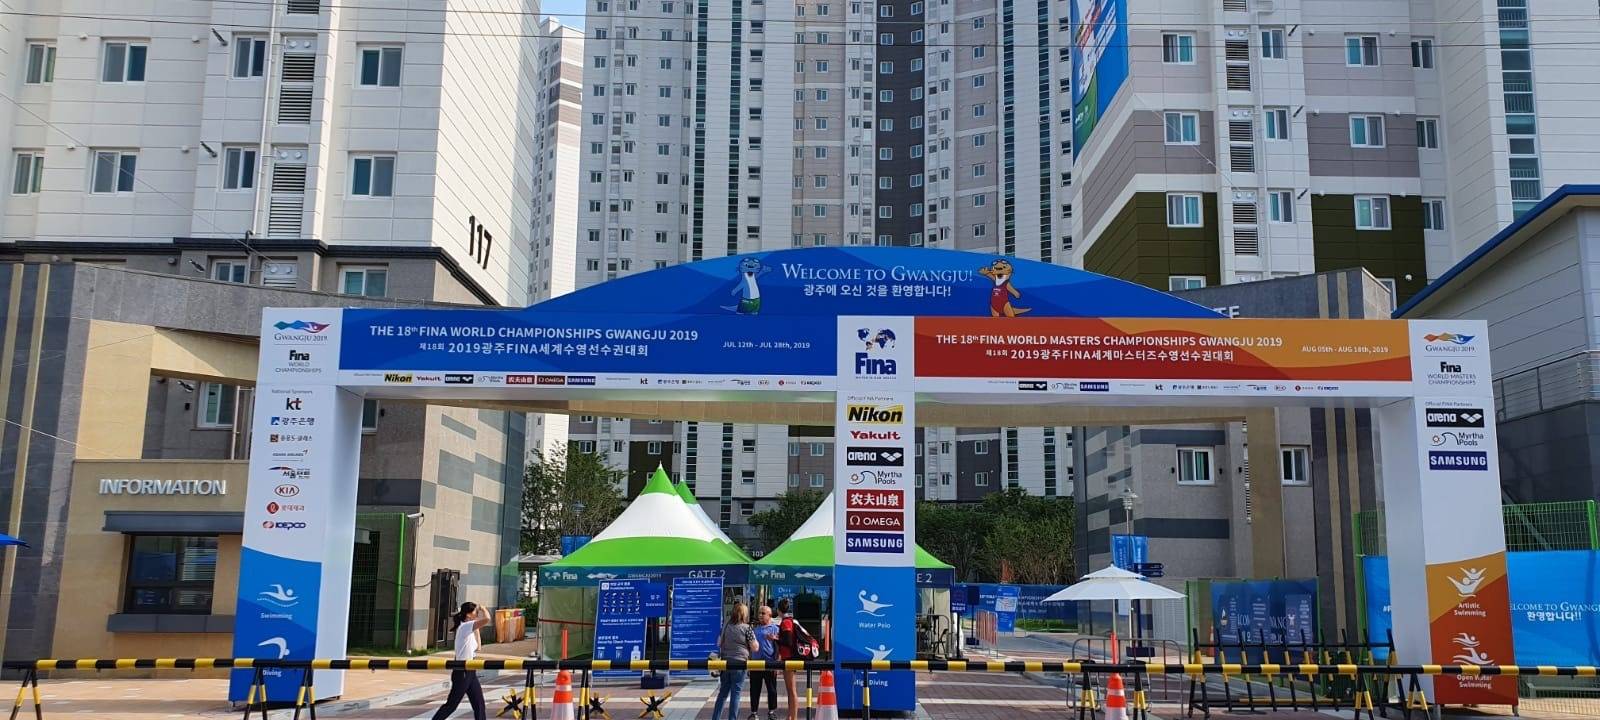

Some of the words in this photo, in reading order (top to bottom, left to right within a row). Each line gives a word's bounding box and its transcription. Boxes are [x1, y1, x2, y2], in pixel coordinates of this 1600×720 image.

[468, 215, 492, 269] 117
[781, 263, 861, 281] WELCOME
[864, 268, 886, 281] TO
[890, 263, 974, 283] GWANGJU!
[803, 284, 837, 297] 광주에
[840, 285, 863, 297] 오신
[866, 285, 888, 297] 것을
[891, 284, 952, 297] 환영합니다!
[274, 333, 312, 342] GWANGJU
[370, 325, 395, 337] THE
[419, 326, 448, 337] FINA
[450, 327, 495, 338] WORLD
[498, 327, 602, 339] CHAMPIONSHIPS
[605, 329, 667, 341] GWANGJU
[670, 330, 698, 341] 2019
[722, 341, 737, 349] JUL
[794, 342, 811, 350] 2019
[936, 334, 957, 345] THE
[980, 335, 1005, 345] FINA
[1006, 335, 1047, 346] WORLD
[1049, 336, 1101, 346] MASTERS
[1103, 336, 1196, 347] CHAMPIONSHIPS
[1199, 336, 1254, 347] GWANGJU
[1256, 337, 1282, 347] 2019
[419, 342, 445, 351] 제18회
[448, 342, 649, 357] 2019광주FINA세계수영선수권대회
[289, 350, 310, 361] Fina
[986, 349, 1008, 357] 제18회
[1011, 349, 1234, 362] 2019광주FINA세계마스터즈수영선수권대회
[855, 352, 897, 375] Fina
[1440, 361, 1461, 373] Fina
[384, 374, 412, 383] Nikon
[286, 398, 302, 410] kt
[848, 406, 903, 423] Nikon
[1427, 413, 1457, 423] arena
[282, 417, 315, 426] 광주은행
[850, 430, 901, 440] Yakult
[1458, 432, 1484, 441] Myrtha
[848, 451, 877, 461] arena
[1430, 455, 1486, 466] SAMSUNG
[877, 471, 902, 480] Myrtha
[878, 477, 896, 485] Pools
[98, 478, 226, 495] INFORMATION
[278, 486, 295, 495] KIA
[851, 493, 899, 506] 农夫山泉
[863, 517, 901, 526] OMEGA
[847, 537, 903, 548] SAMSUNG
[562, 571, 578, 581] Fina
[688, 570, 717, 579] GATE
[720, 569, 726, 579] 2
[770, 569, 786, 579] Fina
[925, 573, 932, 583] 2
[1544, 603, 1558, 611] TO
[260, 612, 292, 620] Swimming
[1454, 609, 1486, 617] Swimming
[1527, 611, 1582, 622] 환영합니다!!
[262, 669, 282, 677] Diving
[1459, 681, 1492, 689] Swimming
